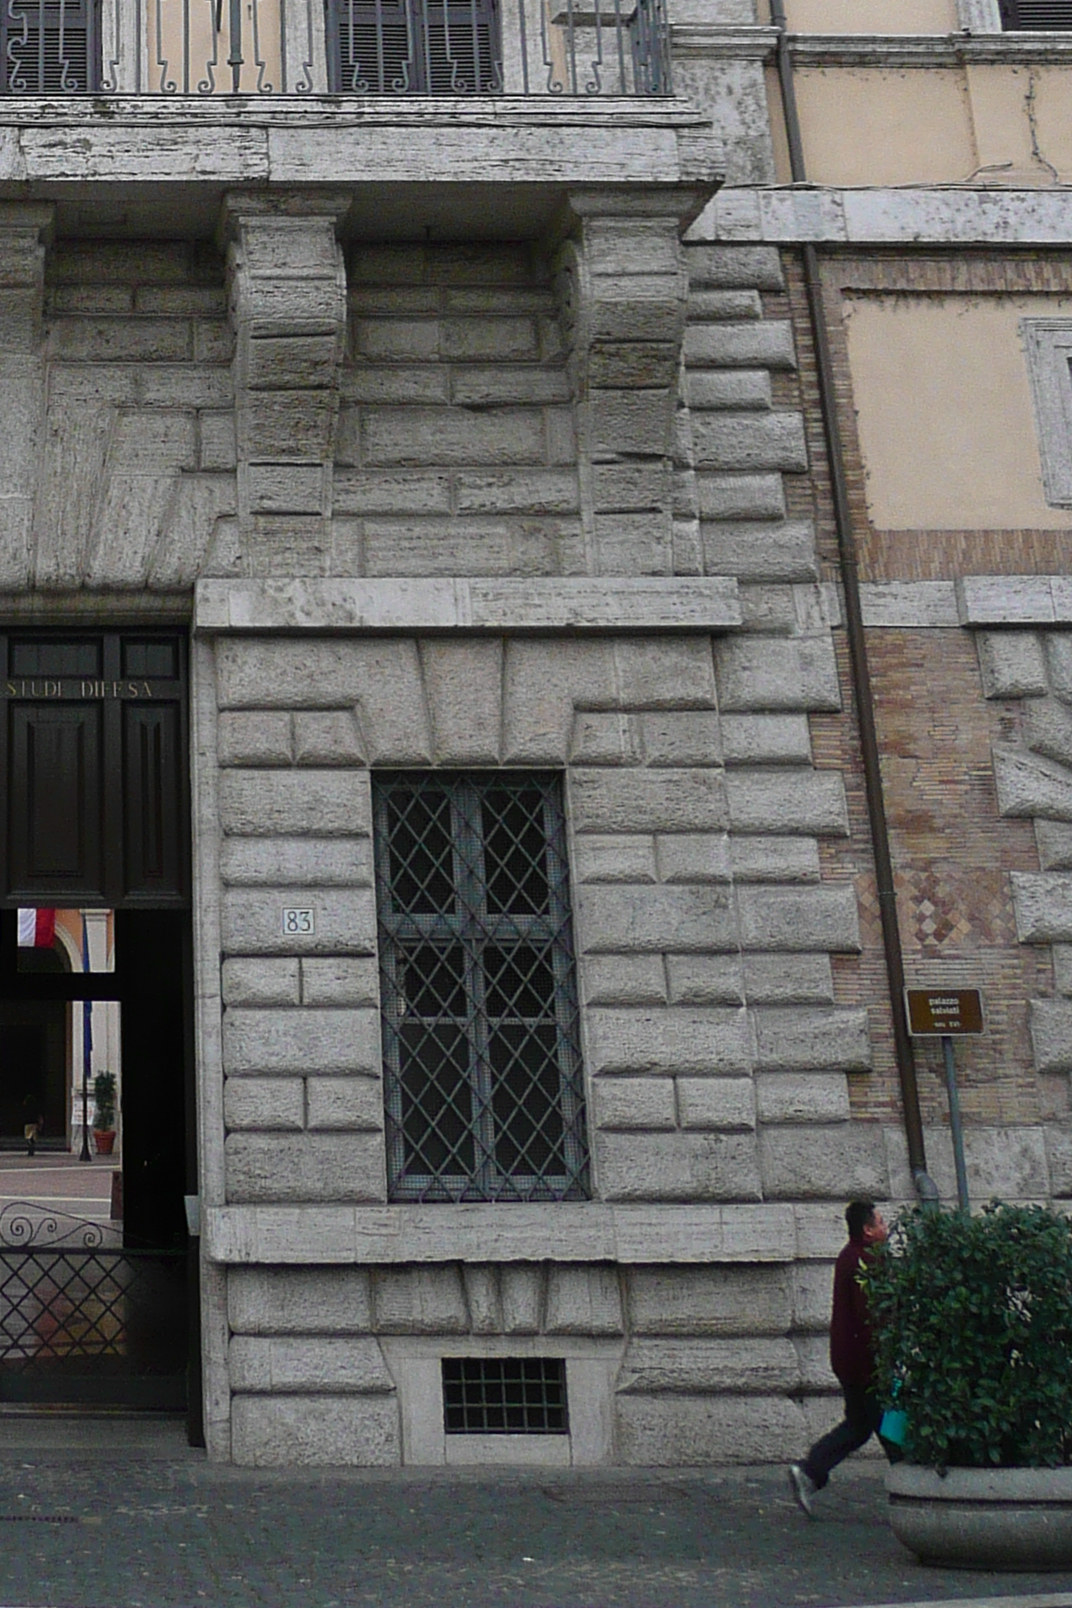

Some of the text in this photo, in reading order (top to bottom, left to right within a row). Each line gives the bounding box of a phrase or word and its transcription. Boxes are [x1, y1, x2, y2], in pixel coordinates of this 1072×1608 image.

[6, 680, 62, 697] STUDI
[81, 680, 152, 698] DIFESA
[287, 911, 311, 931] 83
